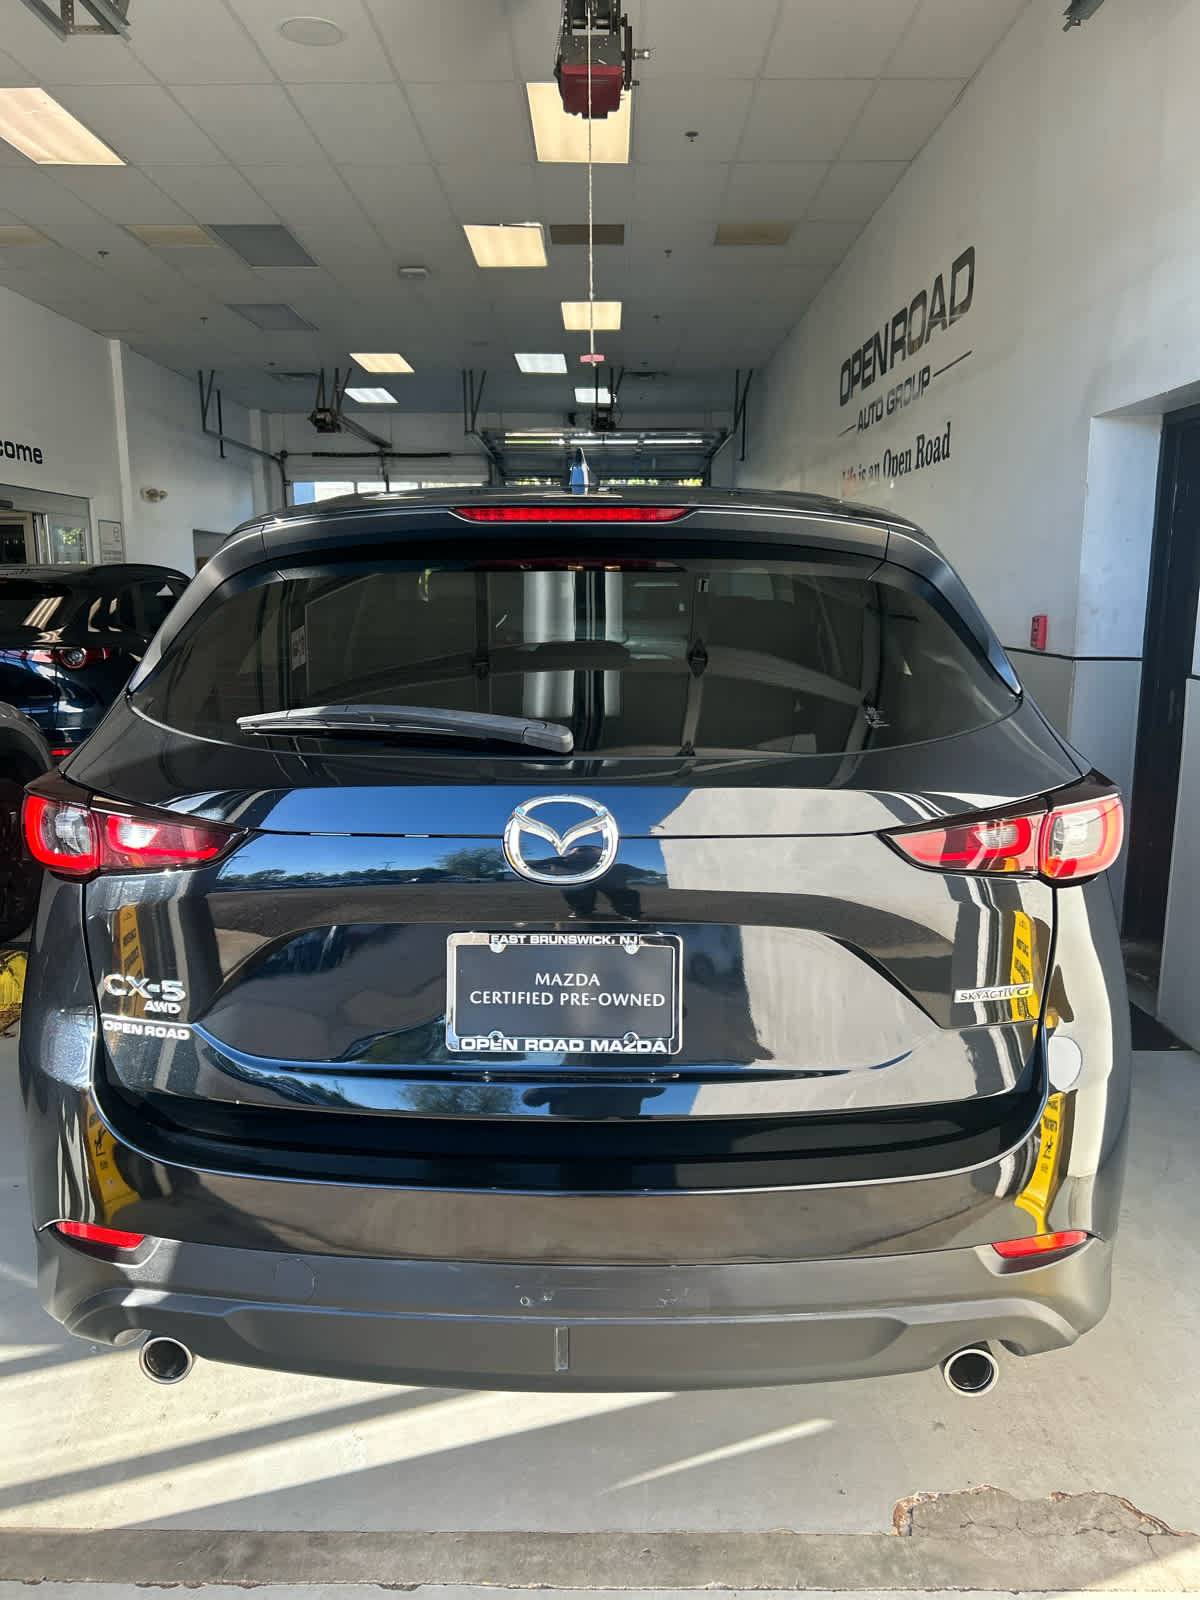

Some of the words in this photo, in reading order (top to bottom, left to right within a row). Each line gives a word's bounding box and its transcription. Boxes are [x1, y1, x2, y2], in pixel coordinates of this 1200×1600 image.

[857, 393, 884, 433] AUTO
[886, 365, 932, 416] GROUP
[882, 448, 912, 480] Open
[914, 421, 952, 470] Road
[490, 934, 526, 945] EAST
[619, 935, 638, 946] NJ
[103, 973, 186, 1002] CX-5
[534, 972, 601, 987] MAZDA
[469, 990, 554, 1006] CERTIFIED
[559, 991, 666, 1007] PRE-OWNED
[143, 1000, 182, 1014] AWD
[461, 1037, 518, 1051] OPEN
[524, 1038, 585, 1052] ROAD
[590, 1039, 669, 1053] MAZDA
